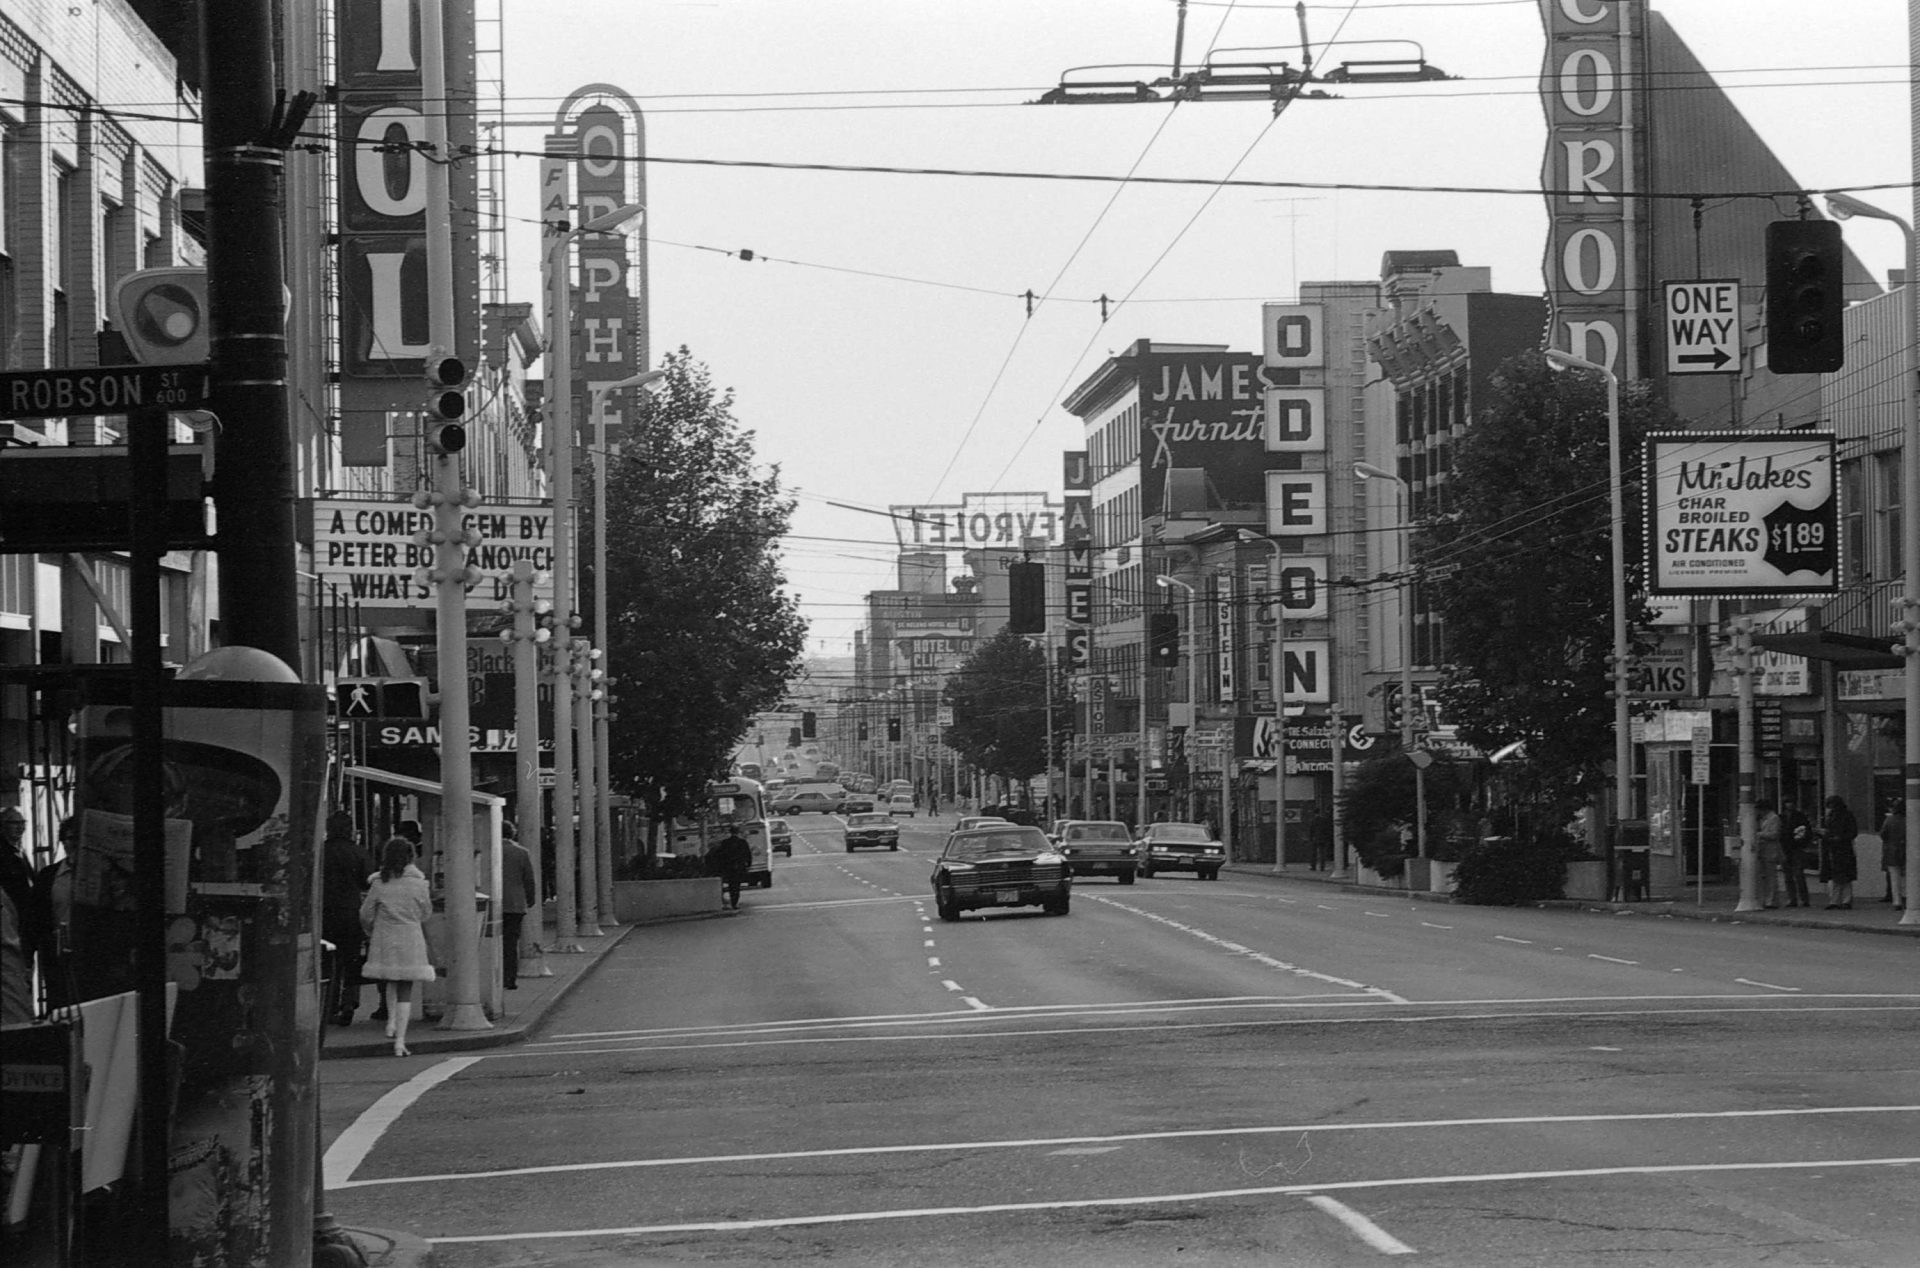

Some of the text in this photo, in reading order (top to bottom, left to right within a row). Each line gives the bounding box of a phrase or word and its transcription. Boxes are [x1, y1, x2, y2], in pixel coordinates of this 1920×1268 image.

[1671, 287, 1733, 315] ONE
[1672, 318, 1734, 346] WAY
[11, 375, 141, 410] ROBSON
[161, 373, 178, 387] ST
[1153, 364, 1274, 401] JAMES
[156, 389, 186, 403] 600
[1726, 456, 1812, 490] Jakes
[1277, 315, 1316, 693] ODEON
[1678, 497, 1726, 510] CHAR
[1679, 511, 1750, 524] BROILED
[330, 511, 548, 540] A COMED GEM BY
[1772, 522, 1825, 554] $1.89
[1665, 527, 1760, 554] STEAKS
[329, 542, 555, 571] PETER BOANOVICH
[1069, 457, 1090, 662] JAMES
[1672, 559, 1745, 568] AIR CONDITIONED
[913, 639, 955, 653] HOTEL
[1220, 605, 1234, 687] STEIN
[1093, 681, 1104, 732] ASTOR
[1290, 739, 1346, 750] CONNECTIN
